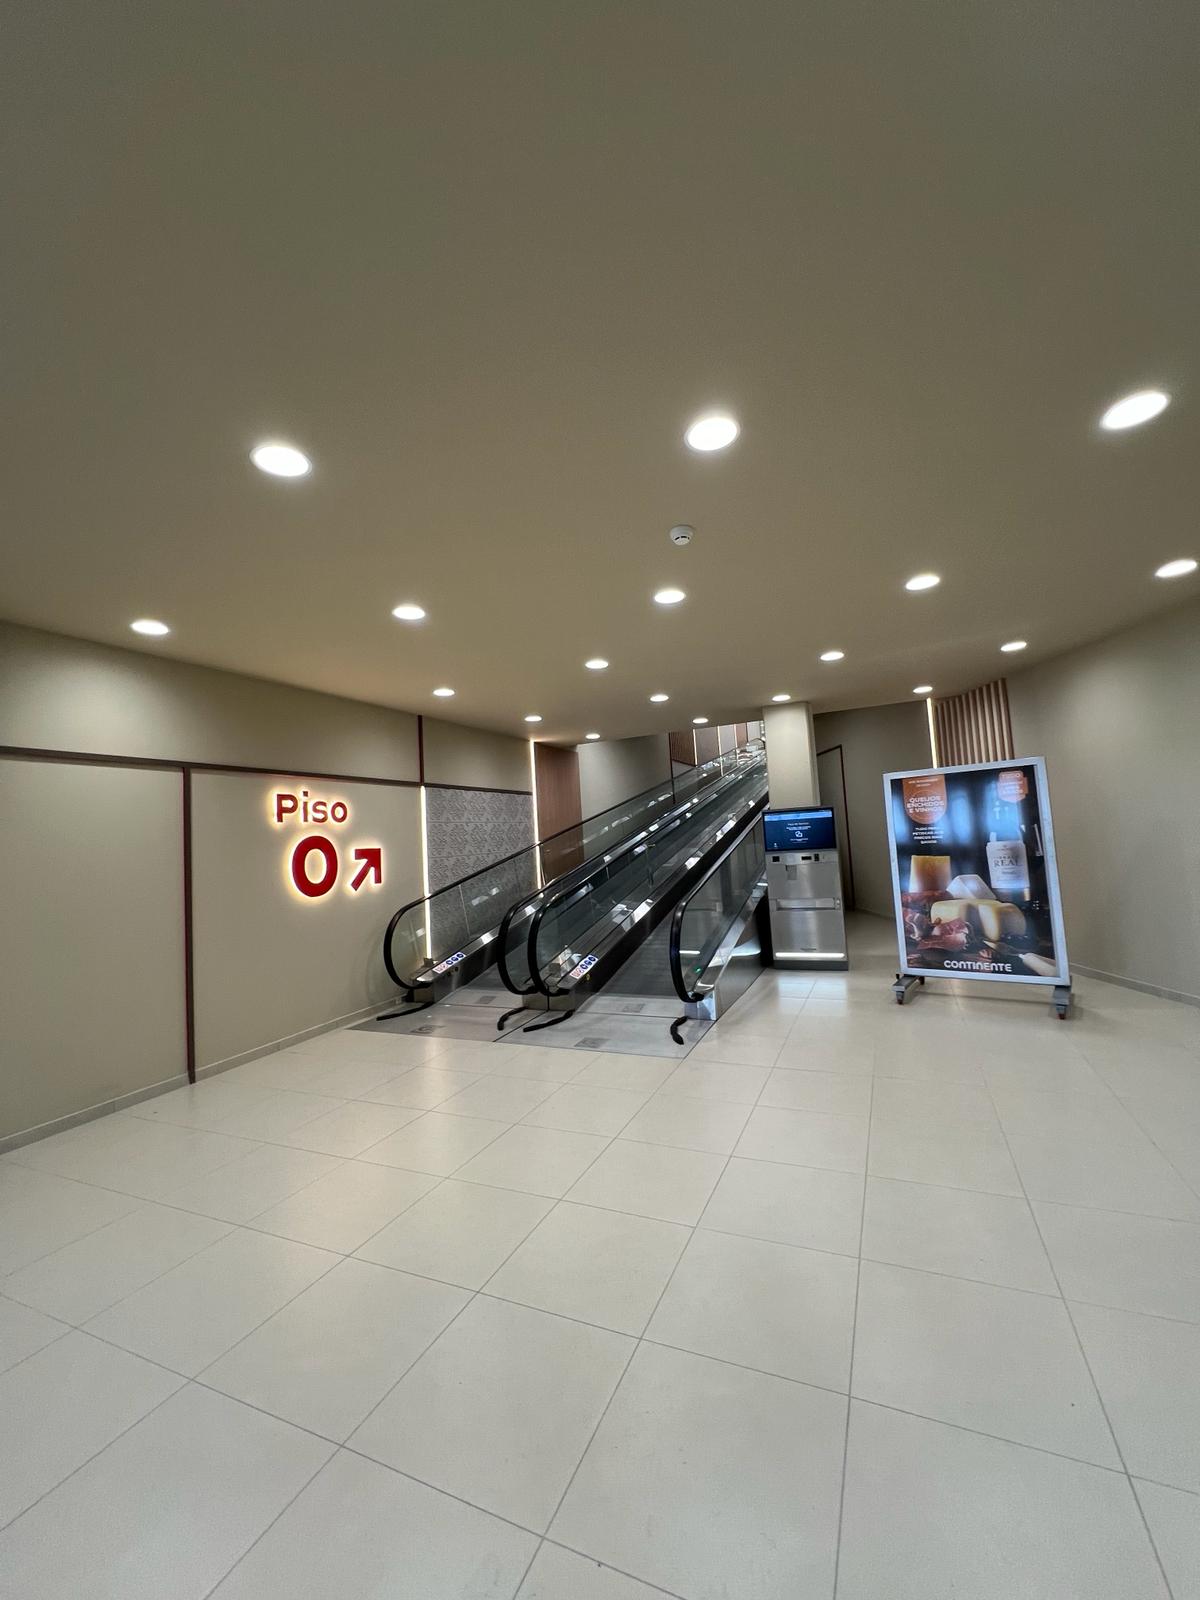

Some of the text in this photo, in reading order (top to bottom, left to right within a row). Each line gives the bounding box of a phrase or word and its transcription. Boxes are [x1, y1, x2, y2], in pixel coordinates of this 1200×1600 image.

[276, 791, 348, 823] Piso
[291, 835, 338, 897] 0
[993, 858, 1023, 868] REAL
[943, 960, 1012, 972] CONTINENTE
